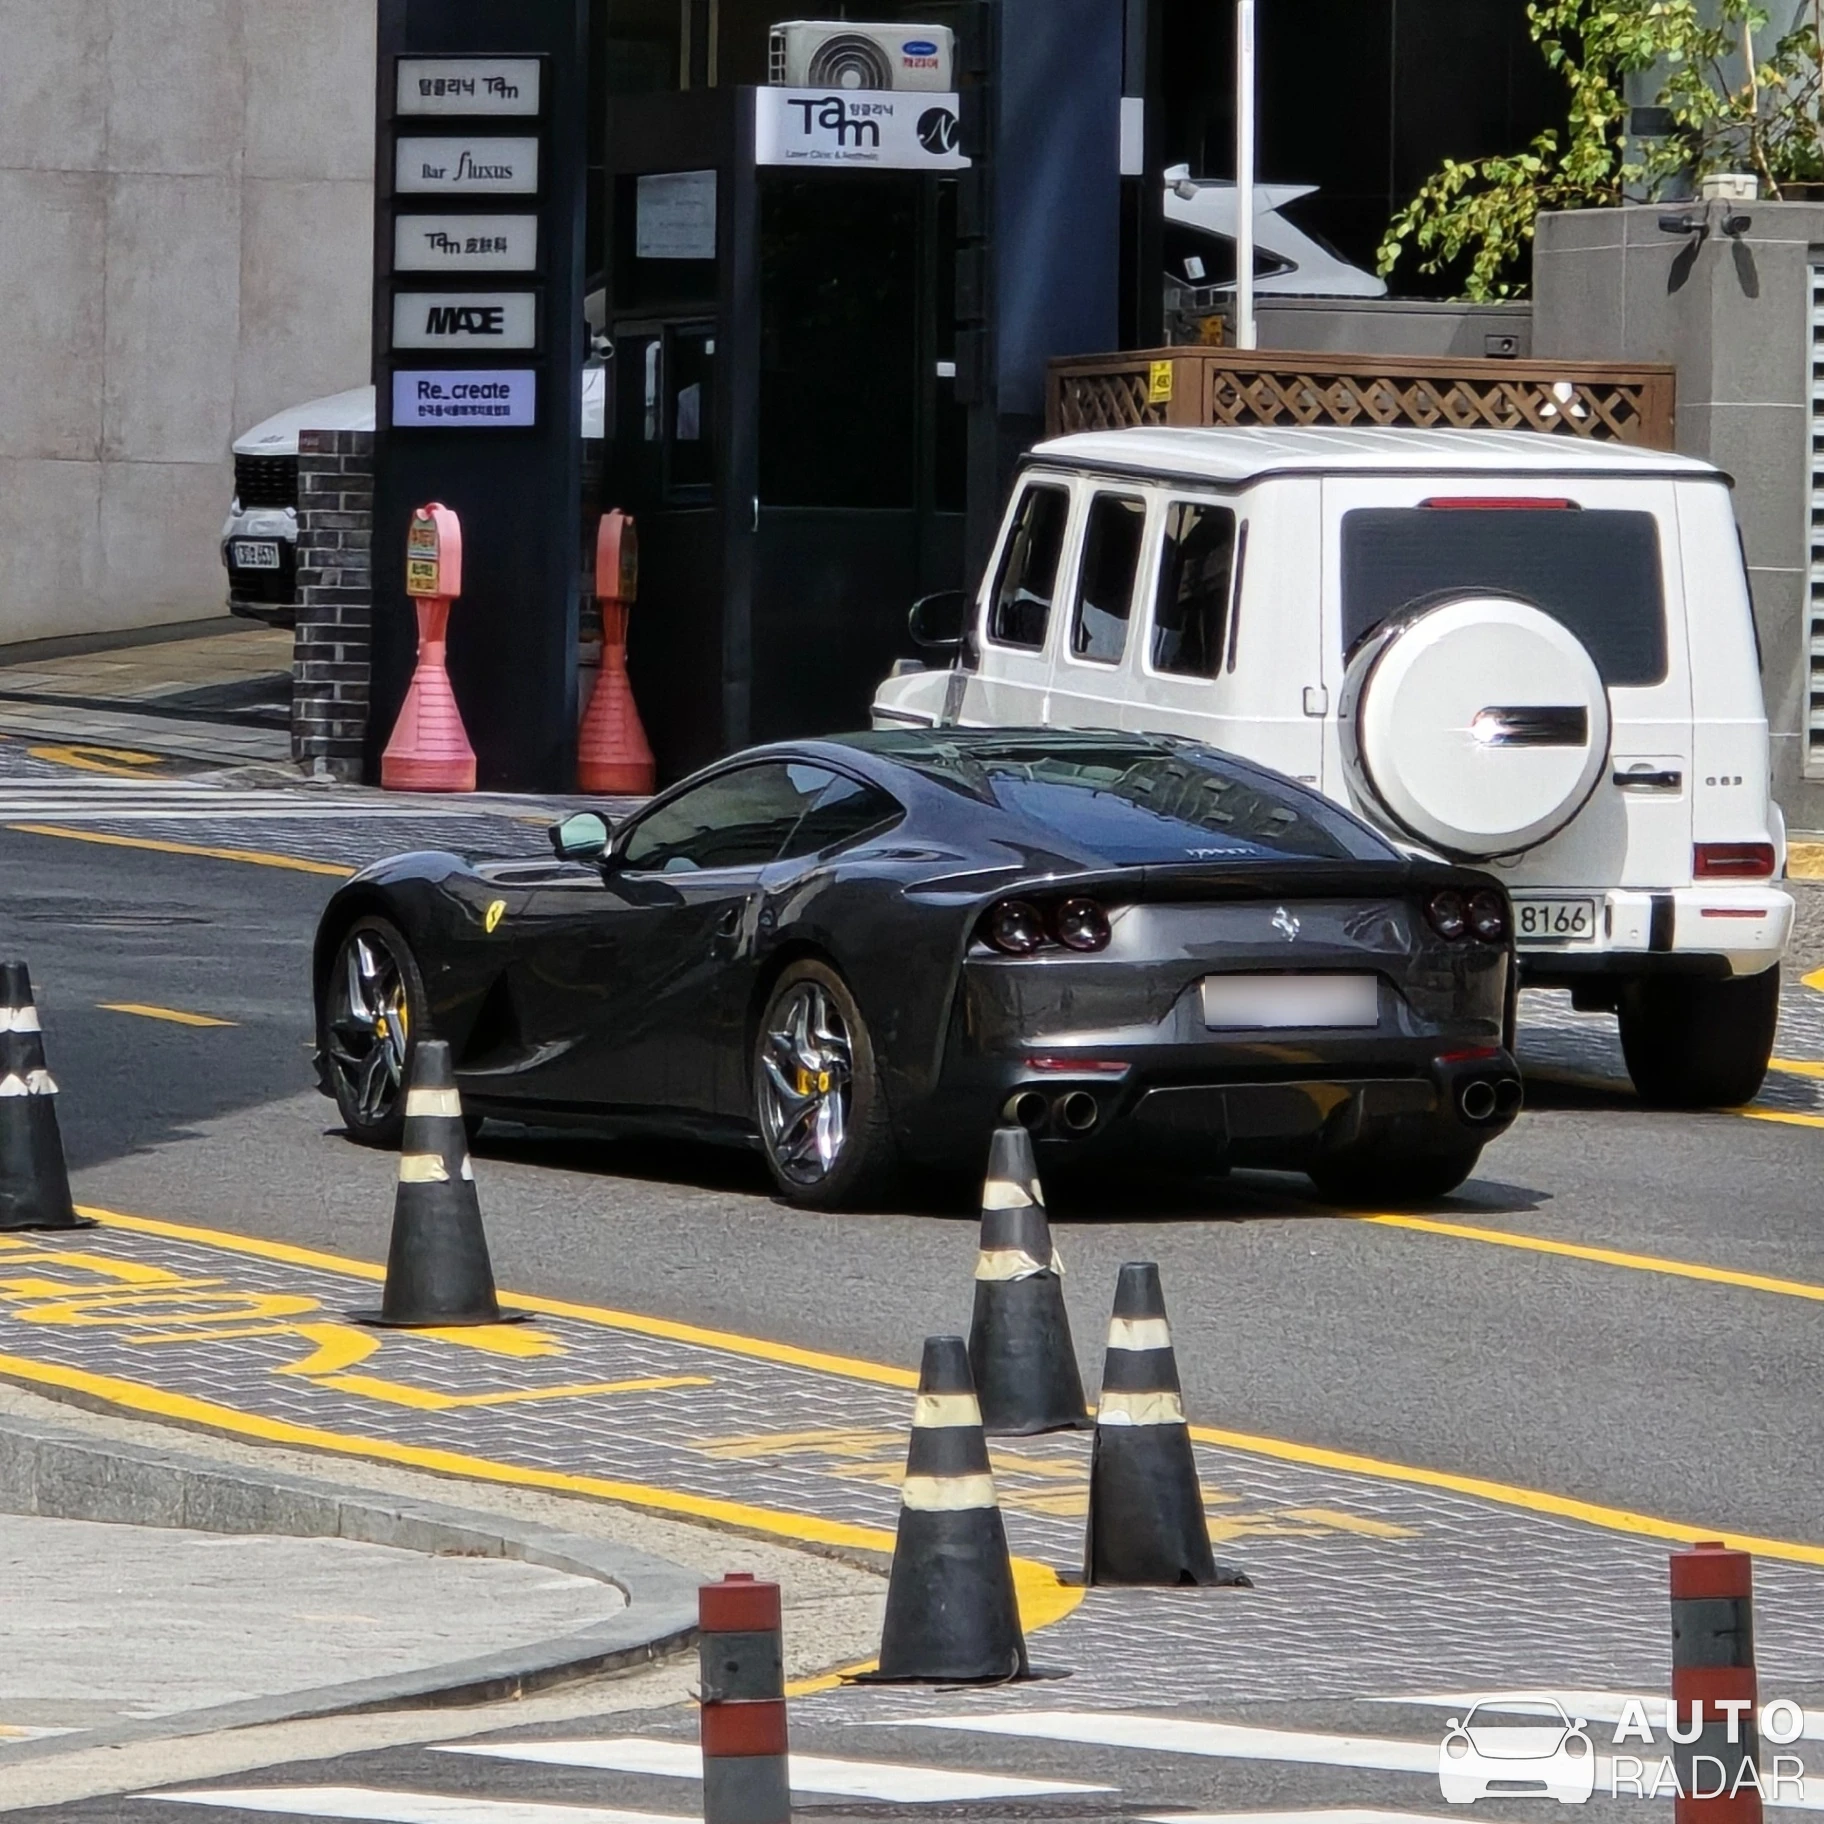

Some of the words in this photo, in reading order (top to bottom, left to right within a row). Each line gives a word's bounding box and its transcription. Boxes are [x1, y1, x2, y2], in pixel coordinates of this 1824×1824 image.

[902, 57, 938, 69] 캐리어
[419, 78, 475, 96] 탐클리닉
[482, 76, 519, 99] Tam
[787, 96, 880, 148] Tam
[422, 163, 447, 179] Bar
[452, 151, 513, 181] fluxus
[423, 232, 461, 254] Tam
[426, 306, 504, 334] MADE
[417, 380, 510, 400] Re_create
[1521, 906, 1587, 933] 8166
